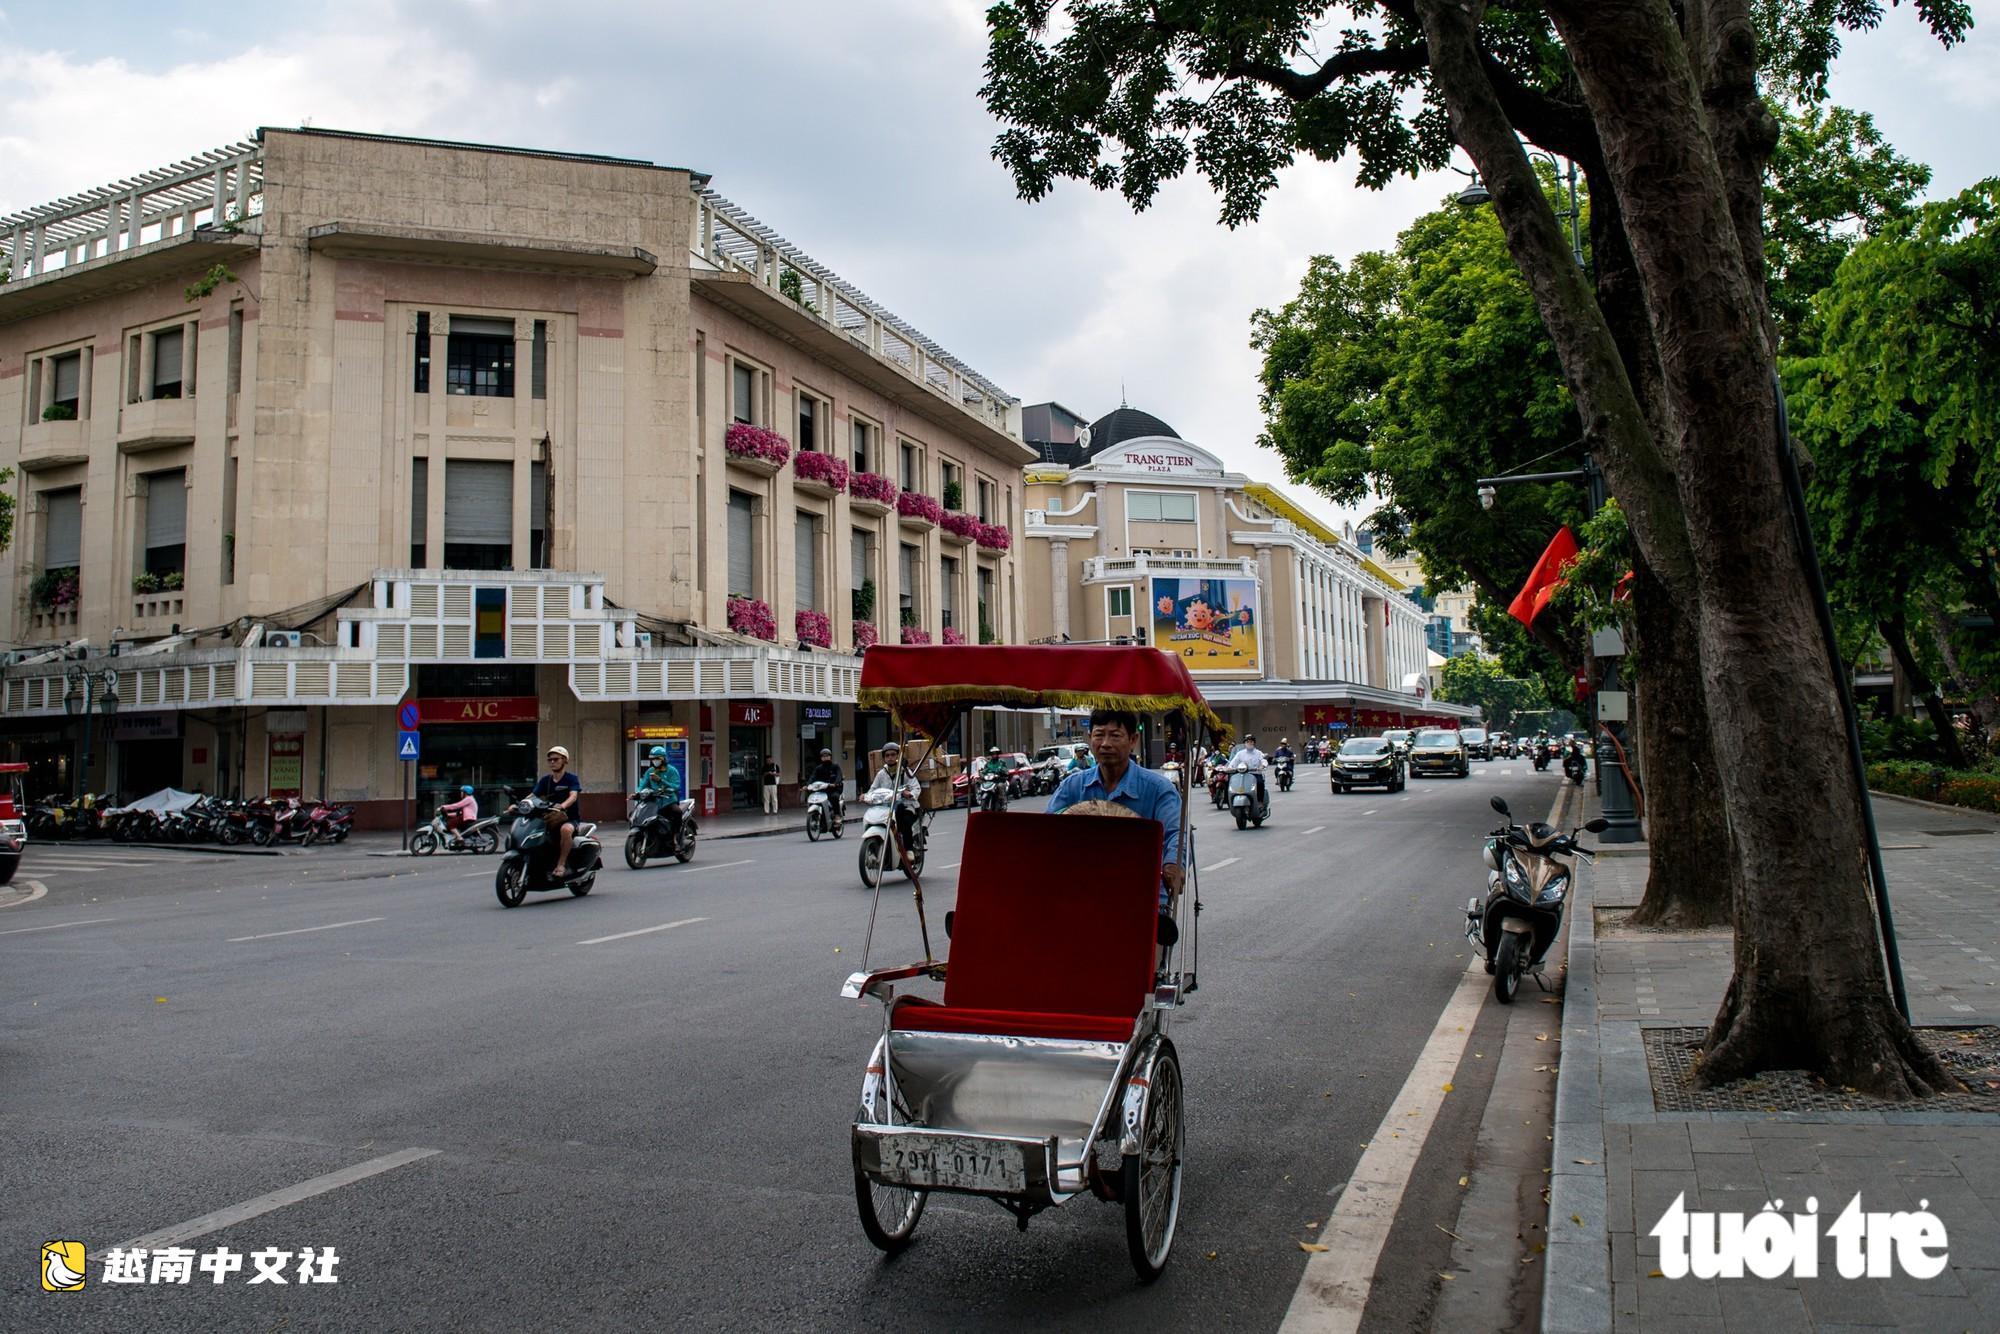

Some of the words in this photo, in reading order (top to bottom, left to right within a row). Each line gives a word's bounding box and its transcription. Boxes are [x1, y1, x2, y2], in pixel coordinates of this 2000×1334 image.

[1124, 453, 1164, 465] TRANG
[1166, 455, 1193, 466] TIEN
[1148, 465, 1171, 473] PLAZA
[461, 702, 499, 719] AJC
[744, 708, 761, 724] AJC
